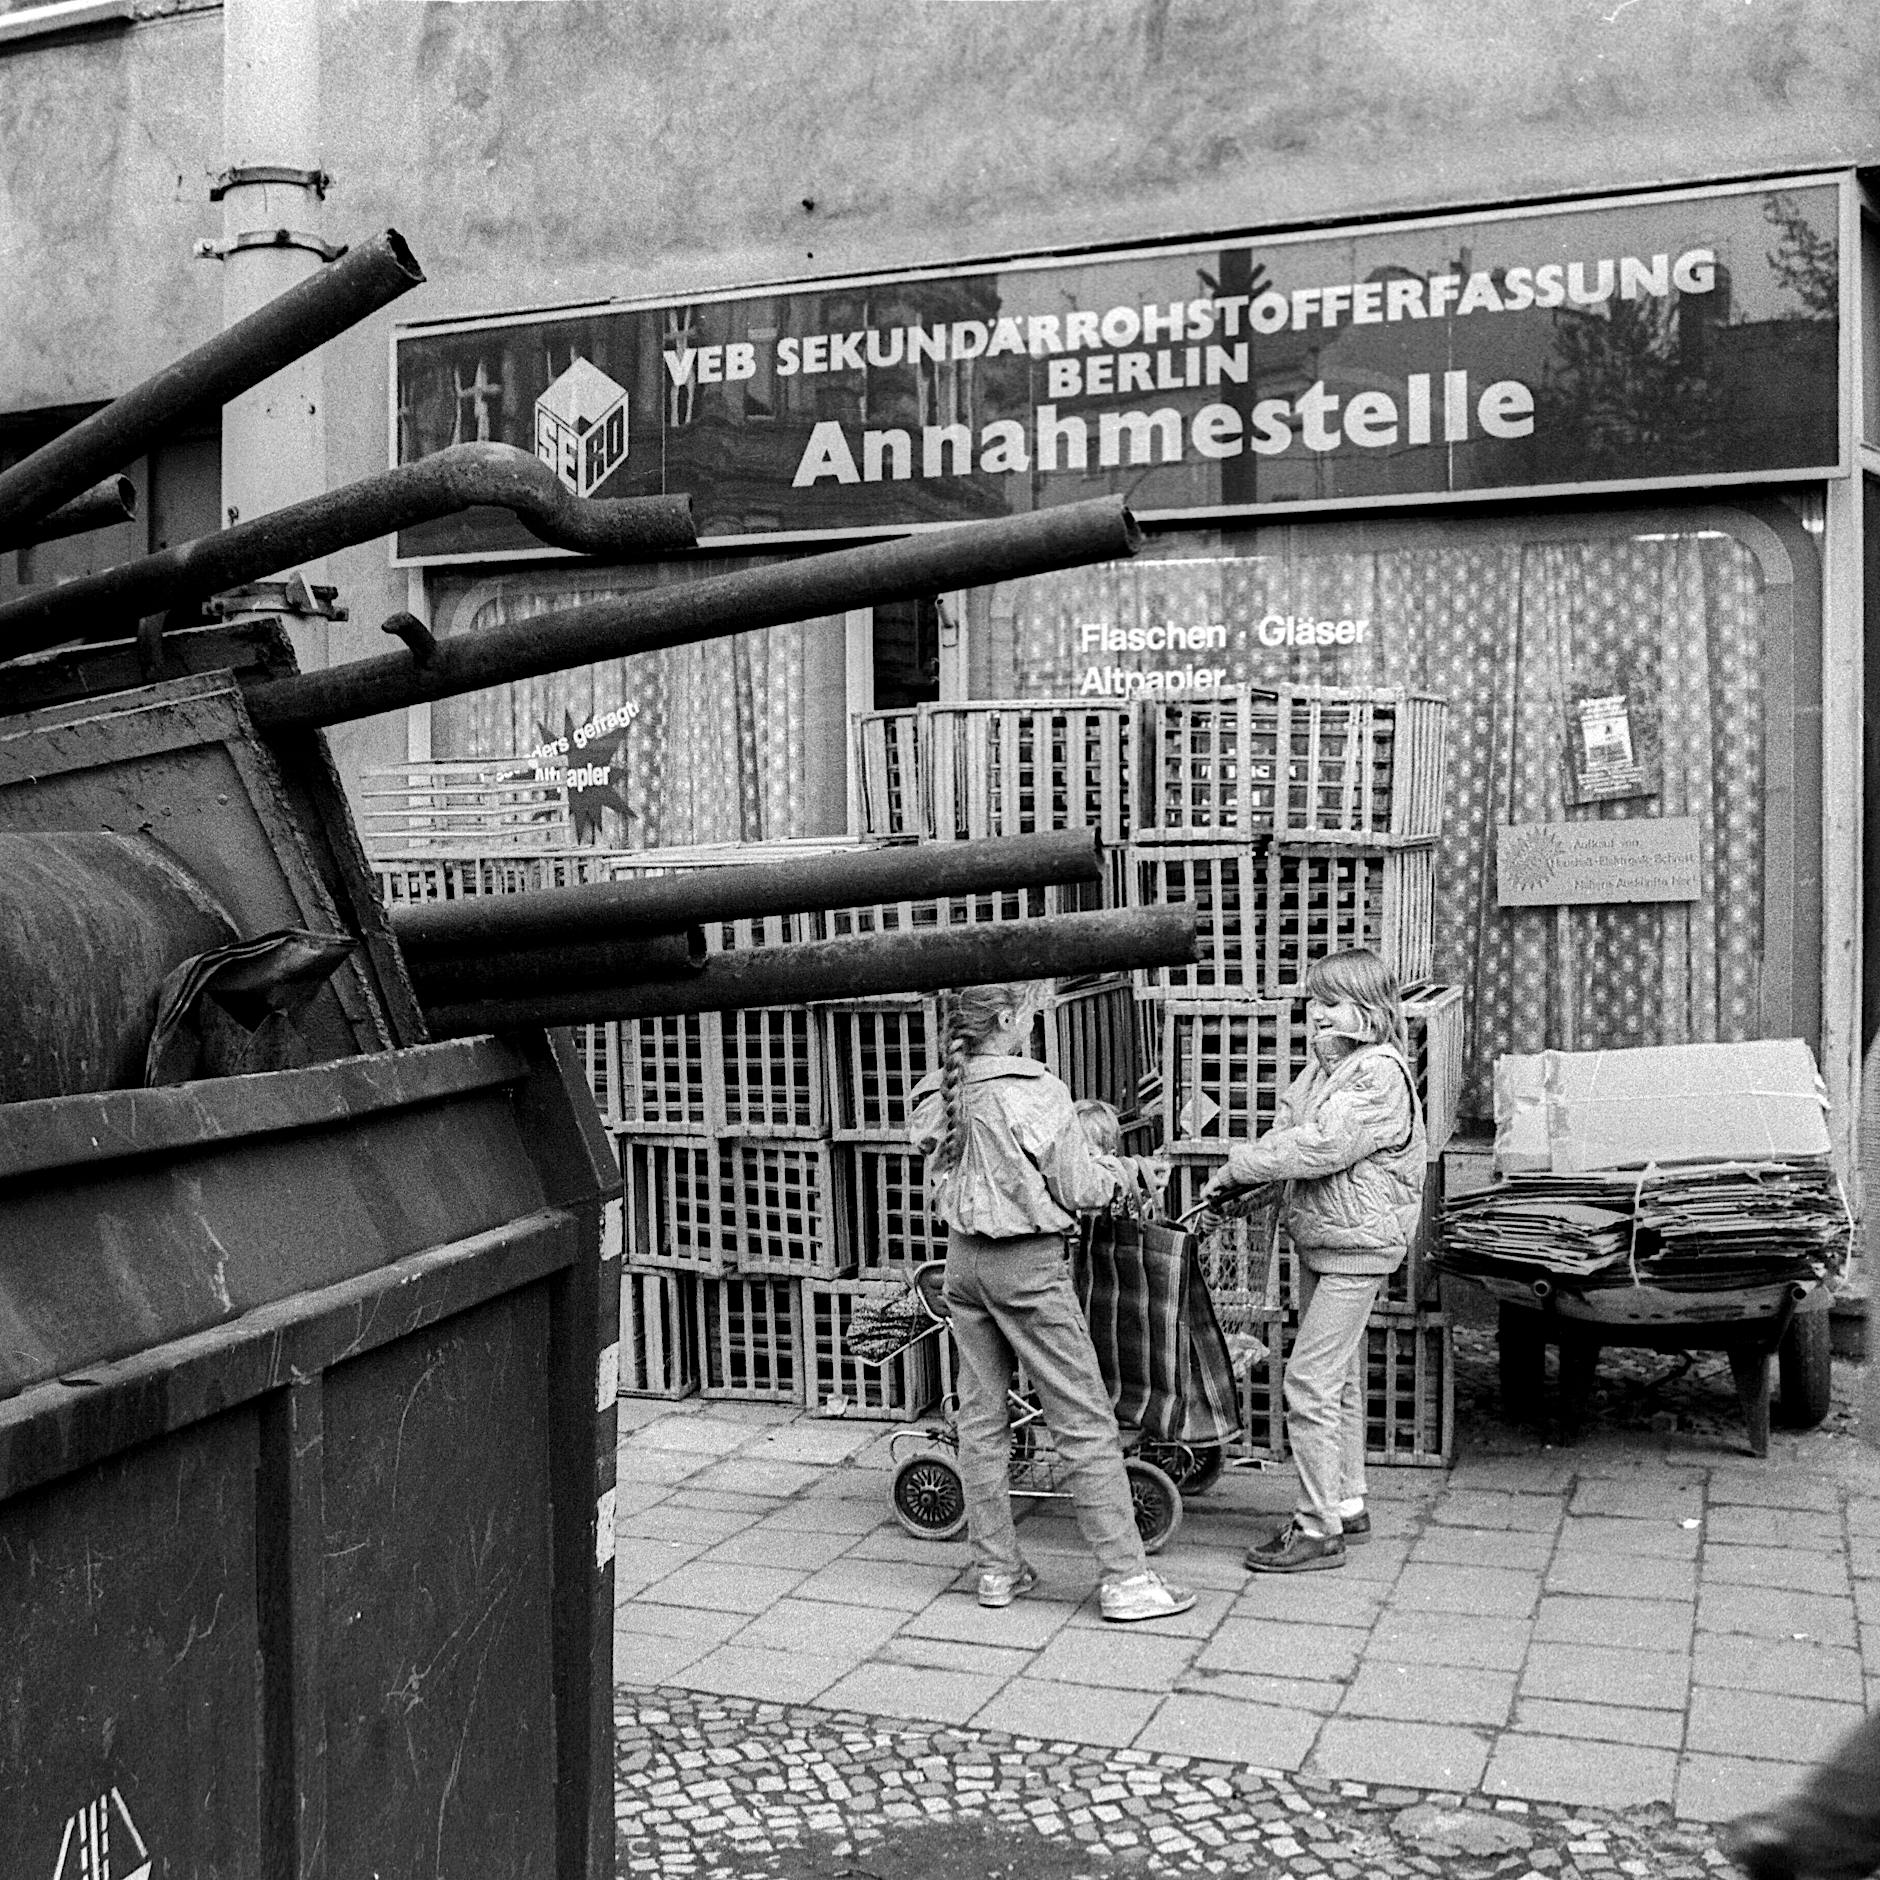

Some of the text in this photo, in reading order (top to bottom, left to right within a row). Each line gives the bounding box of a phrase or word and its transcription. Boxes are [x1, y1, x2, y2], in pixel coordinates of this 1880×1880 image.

[663, 248, 1717, 387] VEB SEKUNDÄRROHSTOFFERFASSUNG
[1049, 341, 1250, 400] BERLIN
[792, 370, 1536, 488] Annahmestelle
[1081, 616, 1370, 653] Flaschen Gläser
